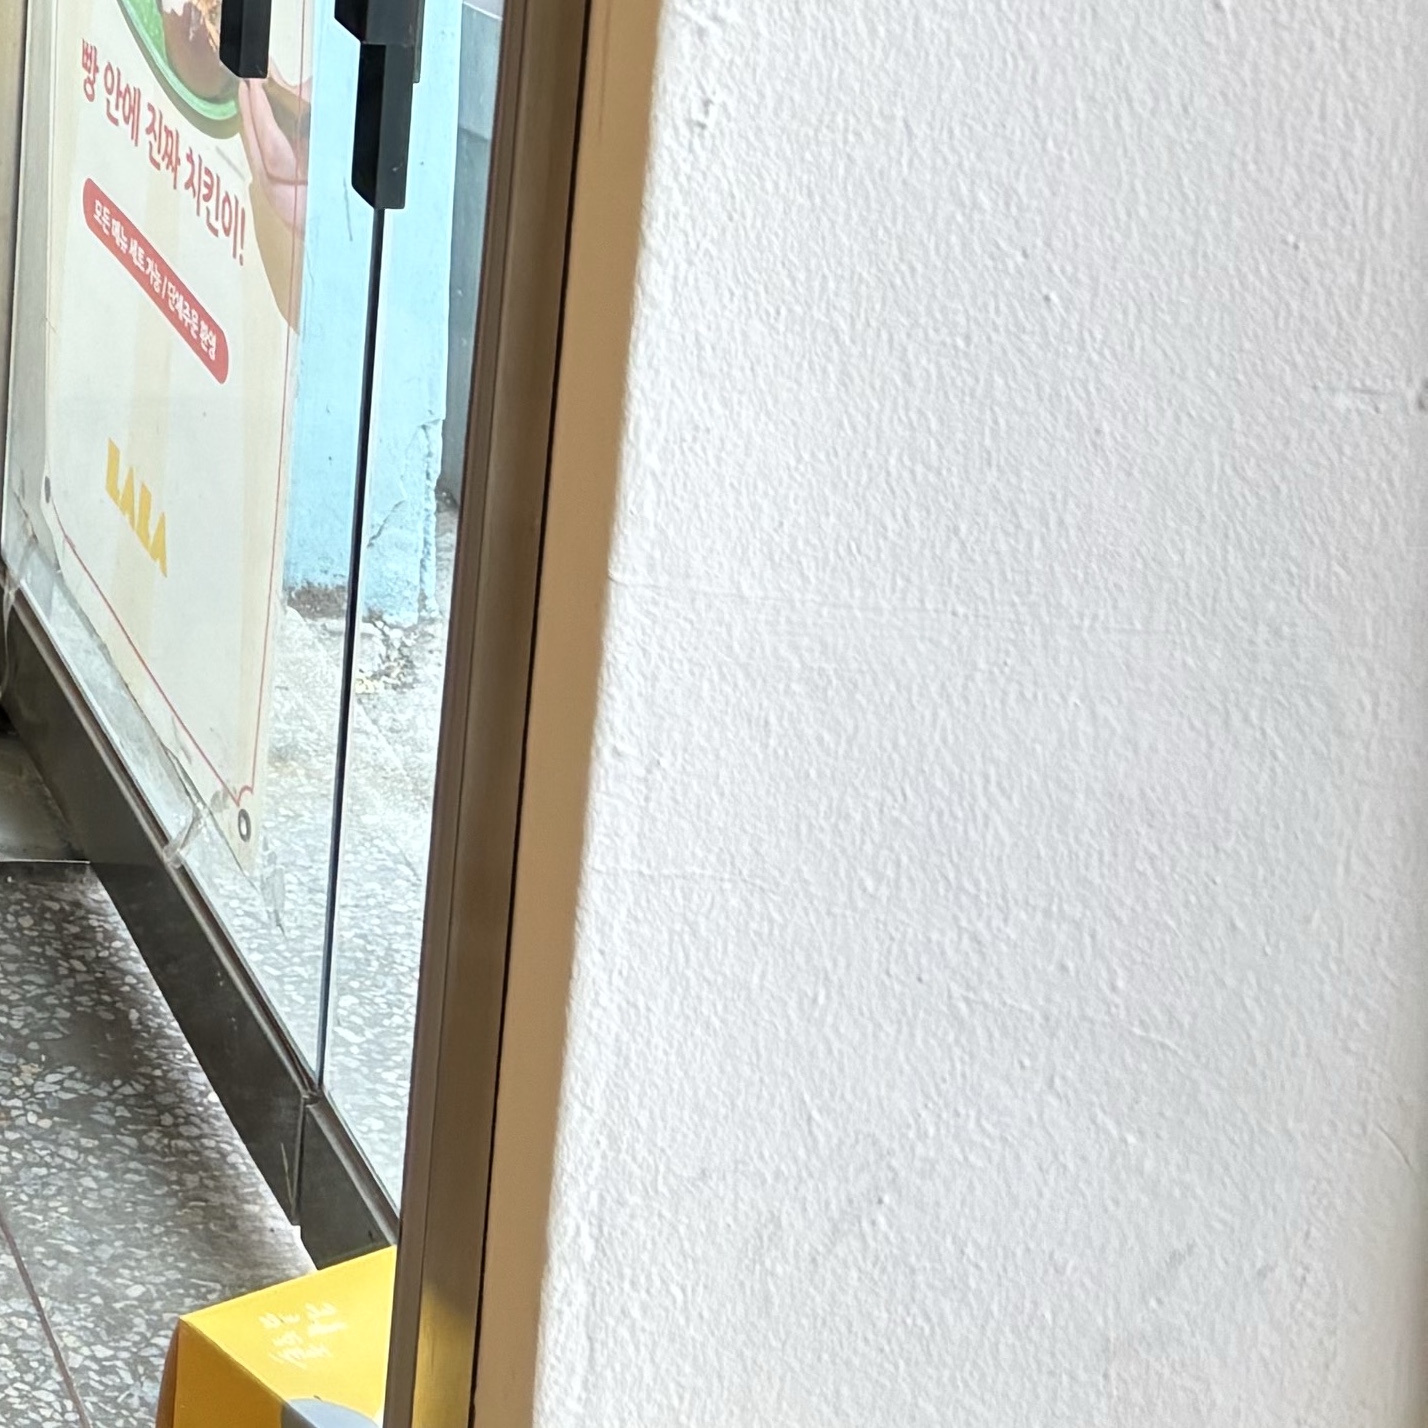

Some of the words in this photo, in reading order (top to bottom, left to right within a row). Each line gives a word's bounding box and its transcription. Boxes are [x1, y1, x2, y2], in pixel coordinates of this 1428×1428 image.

[81, 38, 100, 103] 빵
[103, 61, 142, 148] 안에
[145, 102, 182, 191] 진짜
[185, 146, 246, 267] 치킨이!
[93, 199, 110, 236] 모든
[145, 256, 162, 294] 가능
[105, 436, 168, 579] LALA
